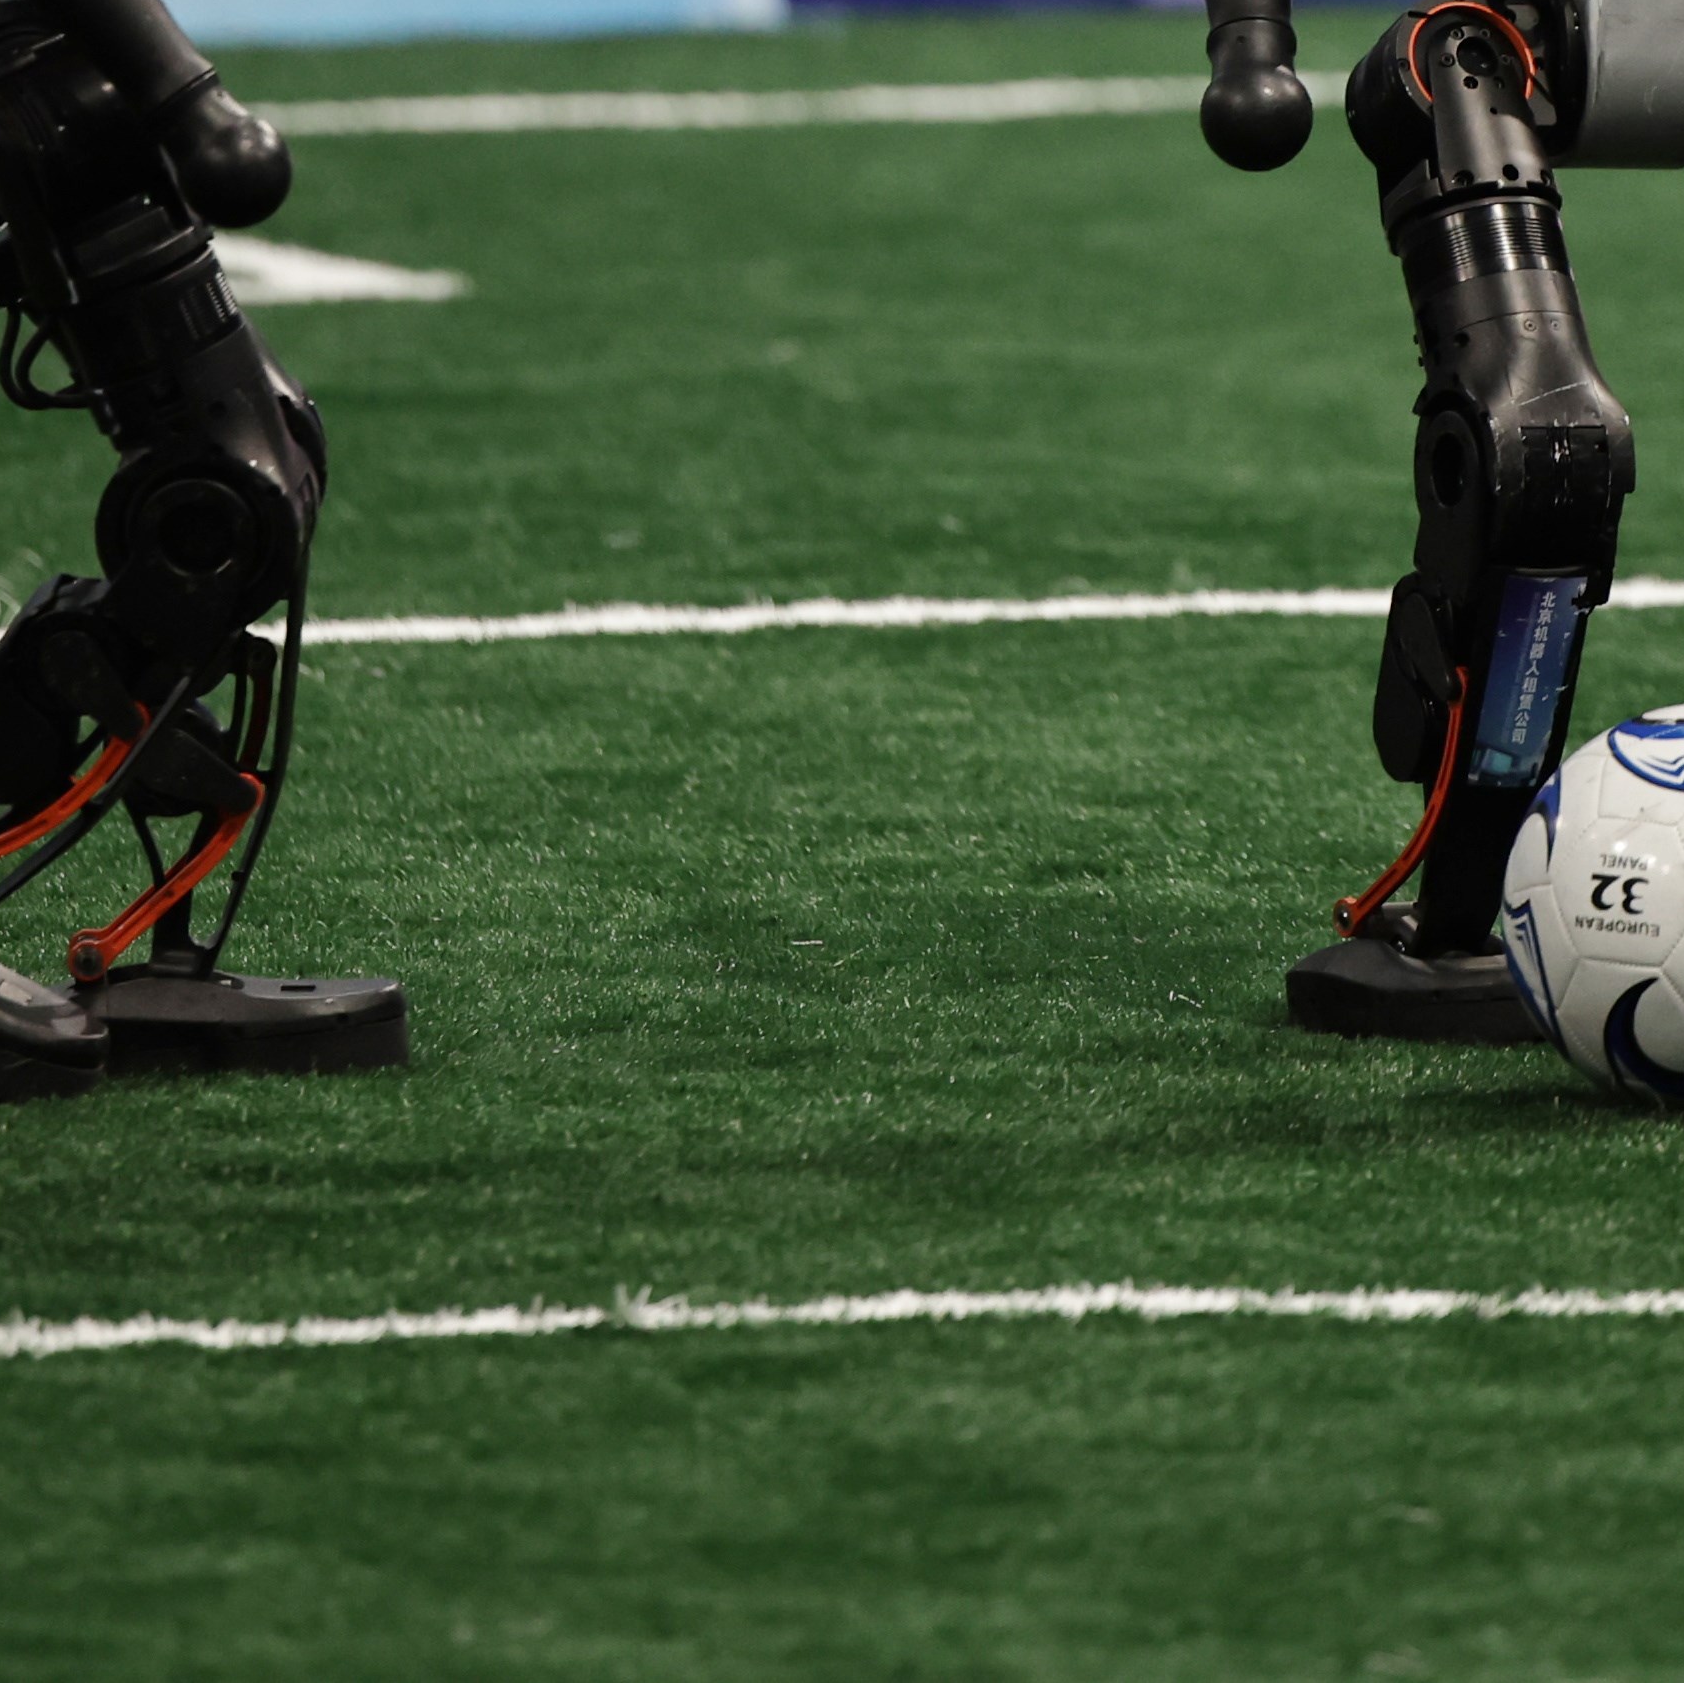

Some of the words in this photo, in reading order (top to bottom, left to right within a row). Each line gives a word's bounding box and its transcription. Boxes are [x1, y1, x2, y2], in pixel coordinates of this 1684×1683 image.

[1600, 854, 1648, 871] PANEL
[1591, 873, 1651, 915] 32
[1574, 915, 1660, 937] EUROPEAN
